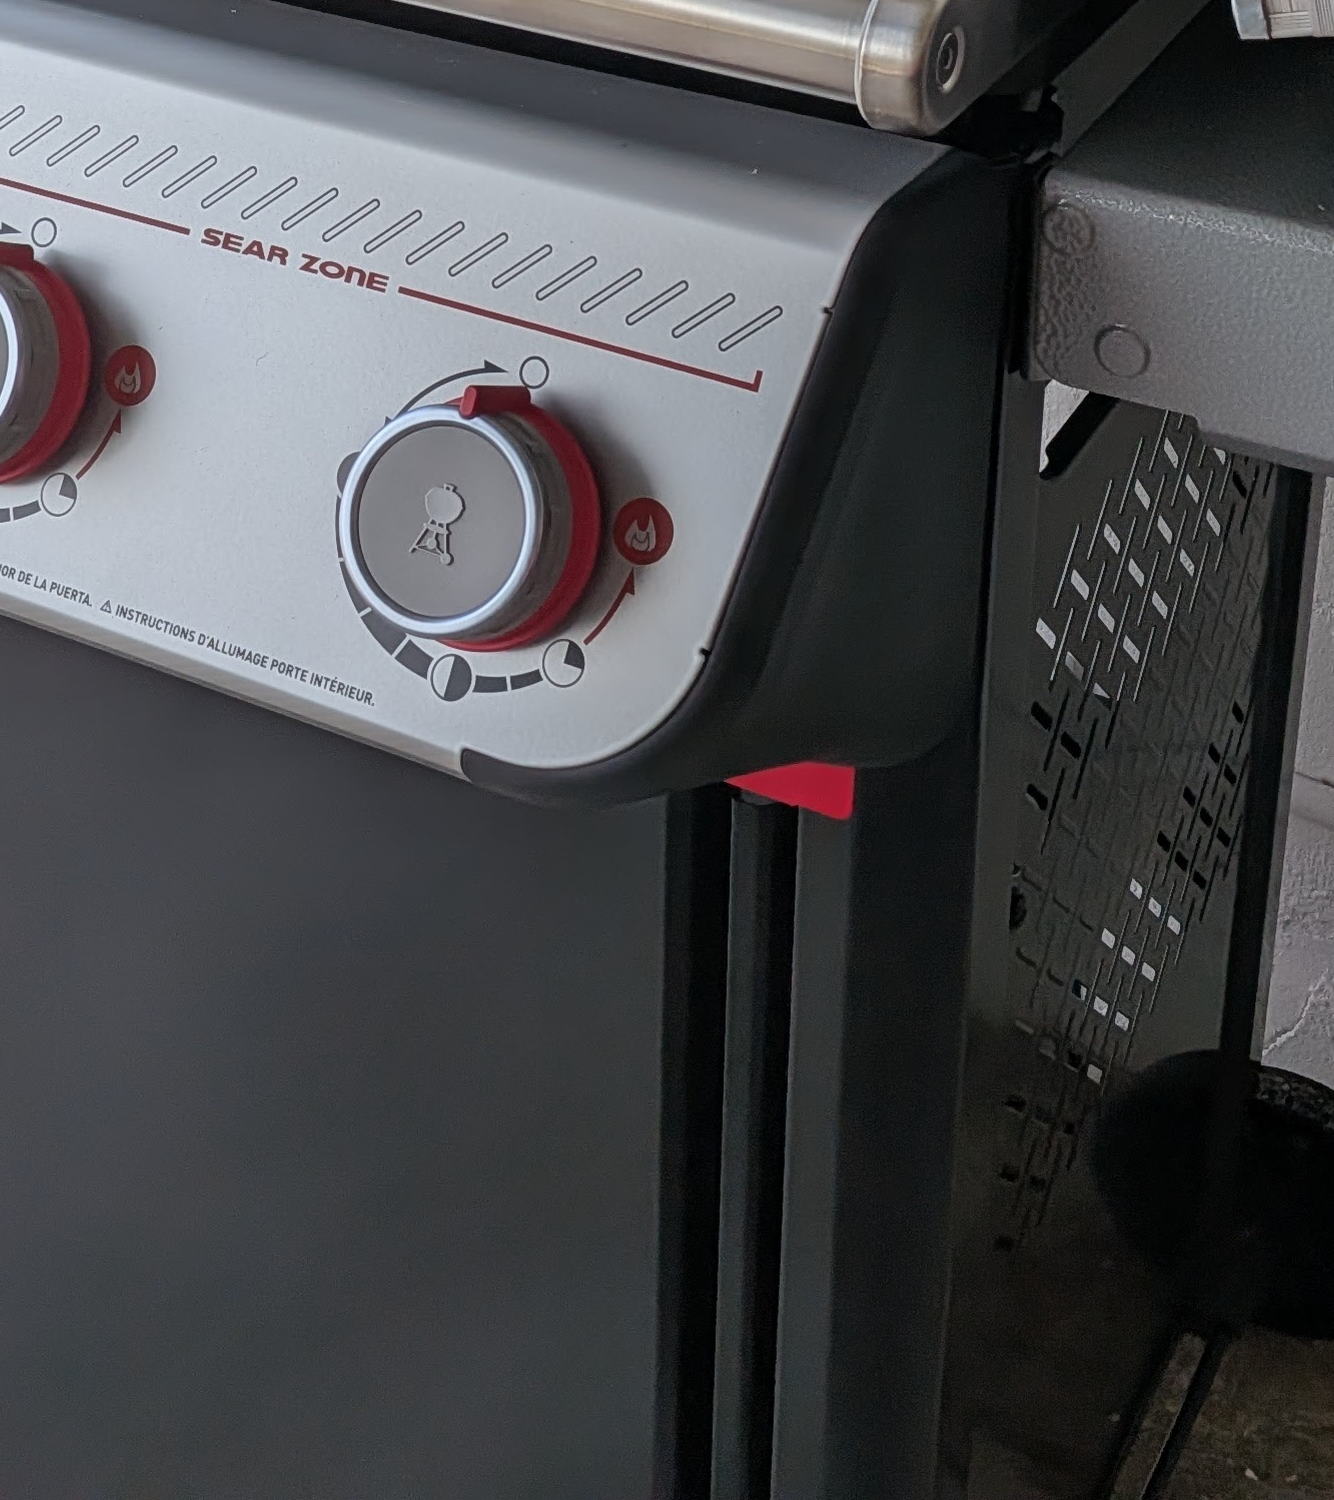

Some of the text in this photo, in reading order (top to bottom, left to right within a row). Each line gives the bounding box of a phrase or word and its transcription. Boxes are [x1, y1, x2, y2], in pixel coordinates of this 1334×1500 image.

[201, 227, 390, 293] SEAR ZONE
[17, 569, 33, 586] DE
[33, 574, 47, 591] LA
[49, 581, 93, 607] PUERTA.
[115, 604, 196, 643] INSTRUCTIONS
[197, 633, 269, 669] D'ALLUMAGE
[270, 659, 309, 683] PORTE
[310, 672, 375, 707] INTÉRIEUR.
